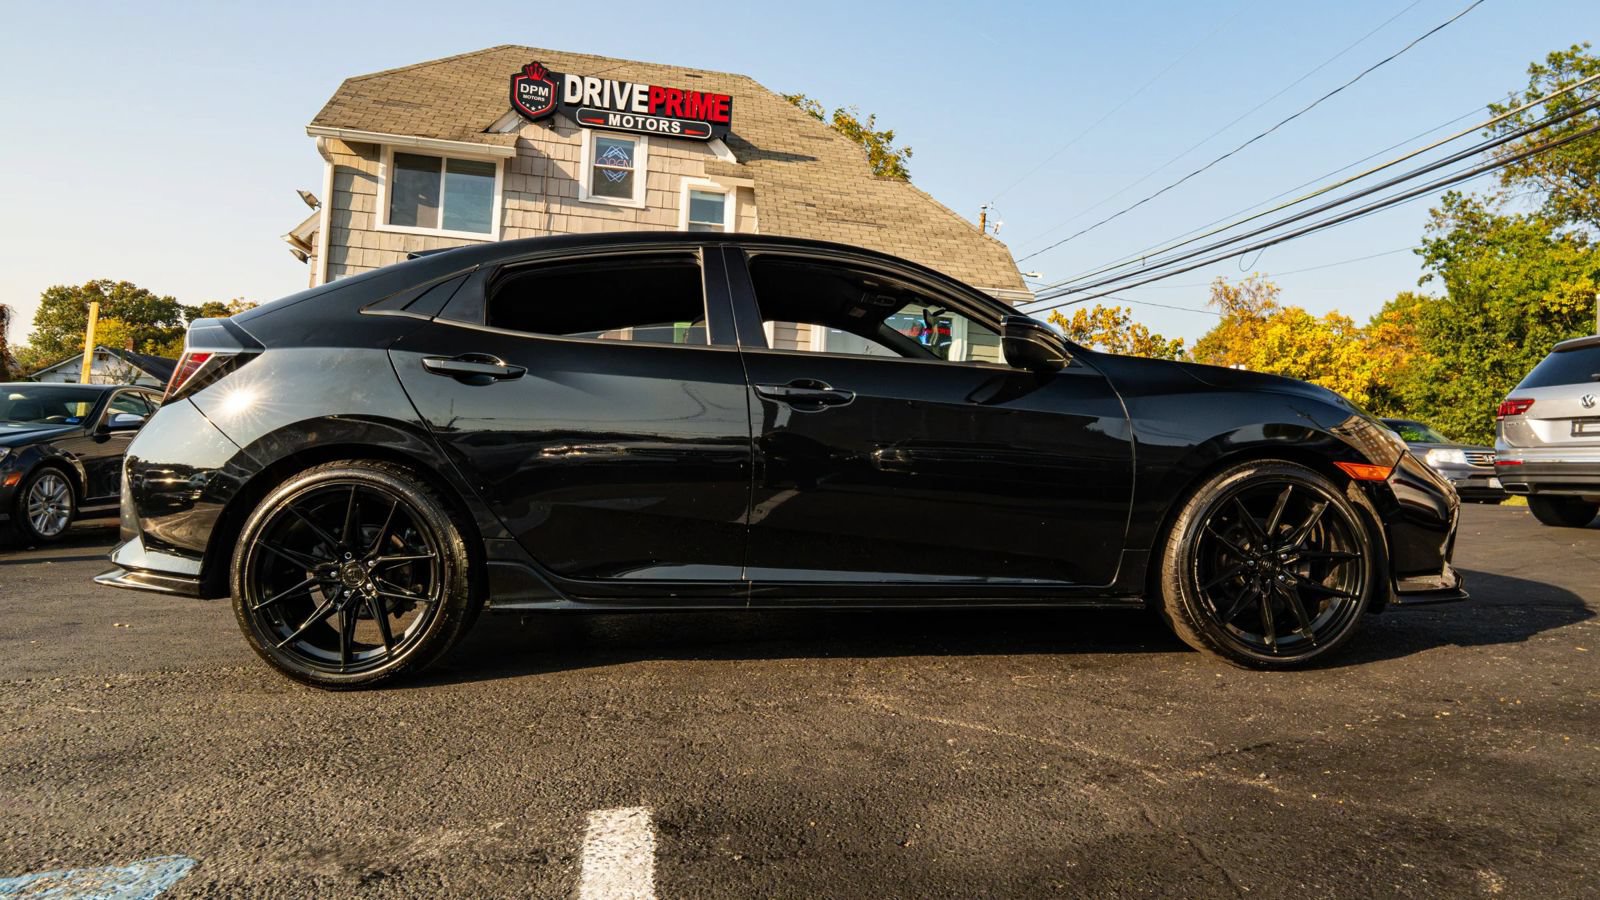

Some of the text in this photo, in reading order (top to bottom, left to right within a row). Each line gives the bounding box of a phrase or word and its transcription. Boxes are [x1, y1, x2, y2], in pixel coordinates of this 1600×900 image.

[520, 83, 549, 97] DPM
[522, 94, 545, 102] MOTORS
[608, 113, 681, 134] MOTORS
